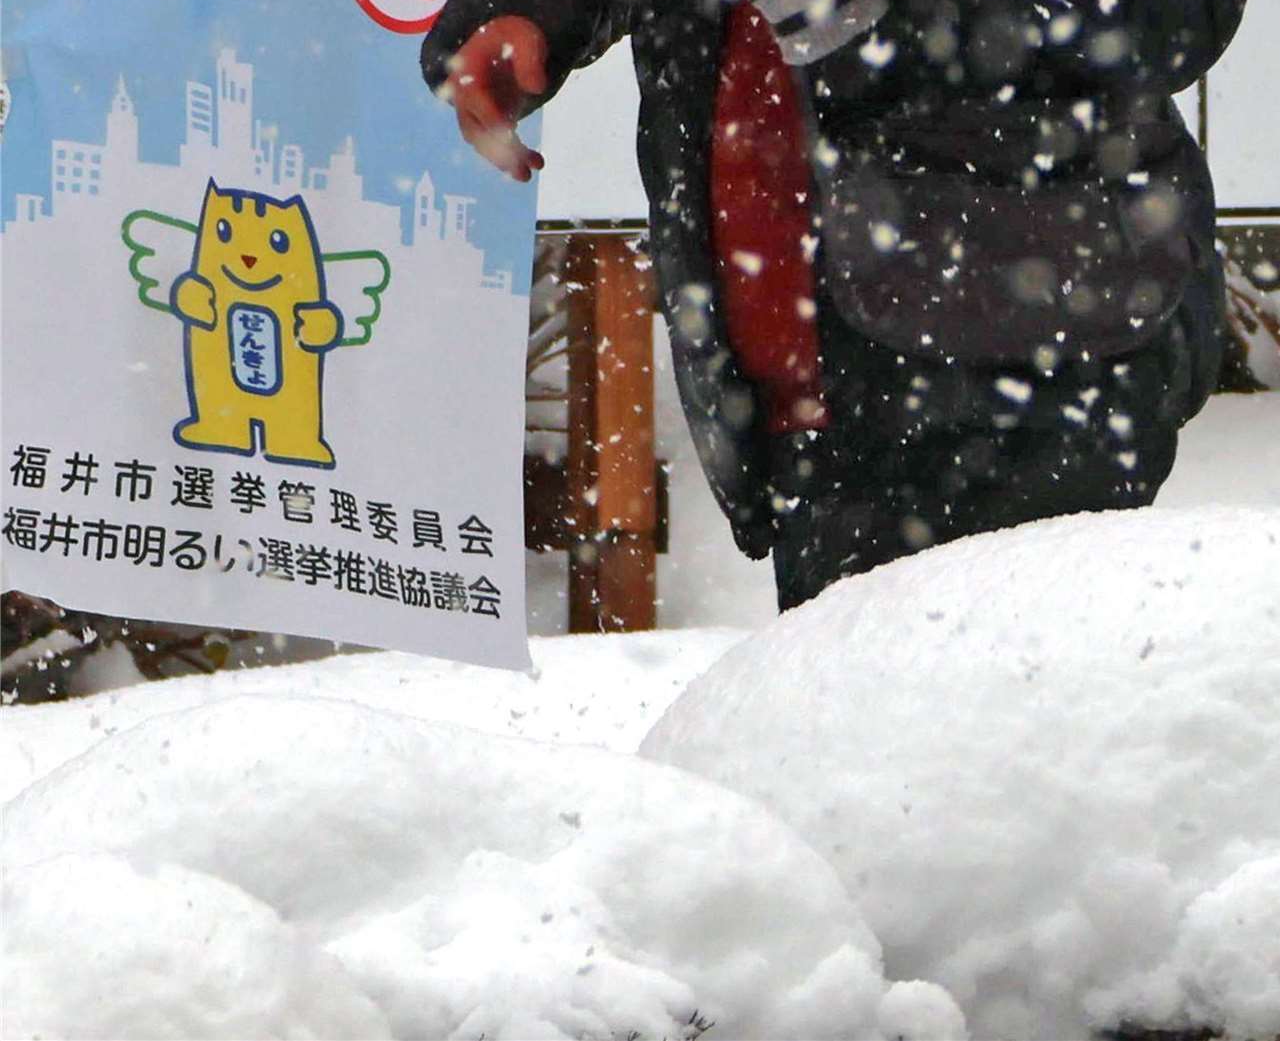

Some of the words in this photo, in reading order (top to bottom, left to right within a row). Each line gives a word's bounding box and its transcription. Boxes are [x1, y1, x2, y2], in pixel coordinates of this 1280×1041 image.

[238, 313, 268, 386] せんきょ
[9, 444, 496, 558] 福井市選挙管理委員会
[0, 506, 502, 620] 福井市明るい選挙推進協議会
